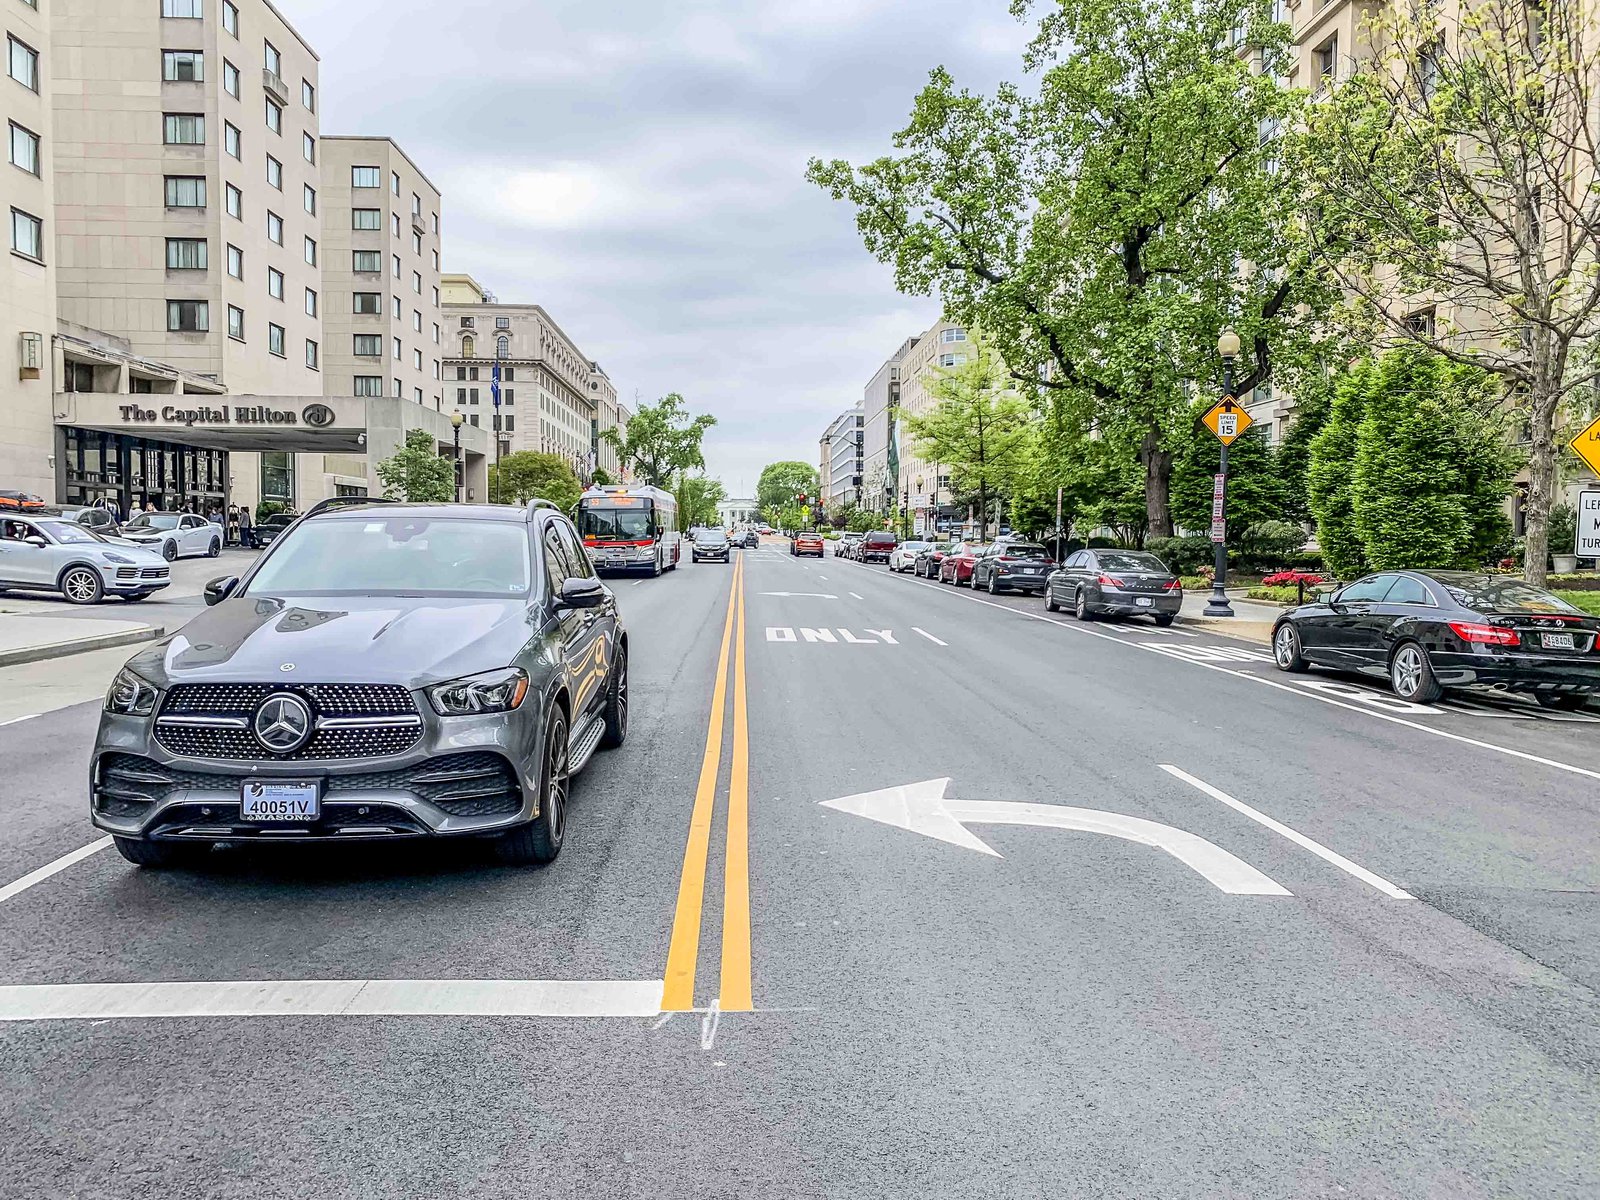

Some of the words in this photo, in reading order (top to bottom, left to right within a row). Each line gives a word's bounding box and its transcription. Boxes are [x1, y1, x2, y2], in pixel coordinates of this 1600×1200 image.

[119, 404, 157, 422] The
[162, 405, 230, 427] Capital
[235, 405, 297, 425] Hilton
[1222, 425, 1233, 434] 15
[765, 627, 900, 644] ONLY
[249, 801, 309, 813] 40051V
